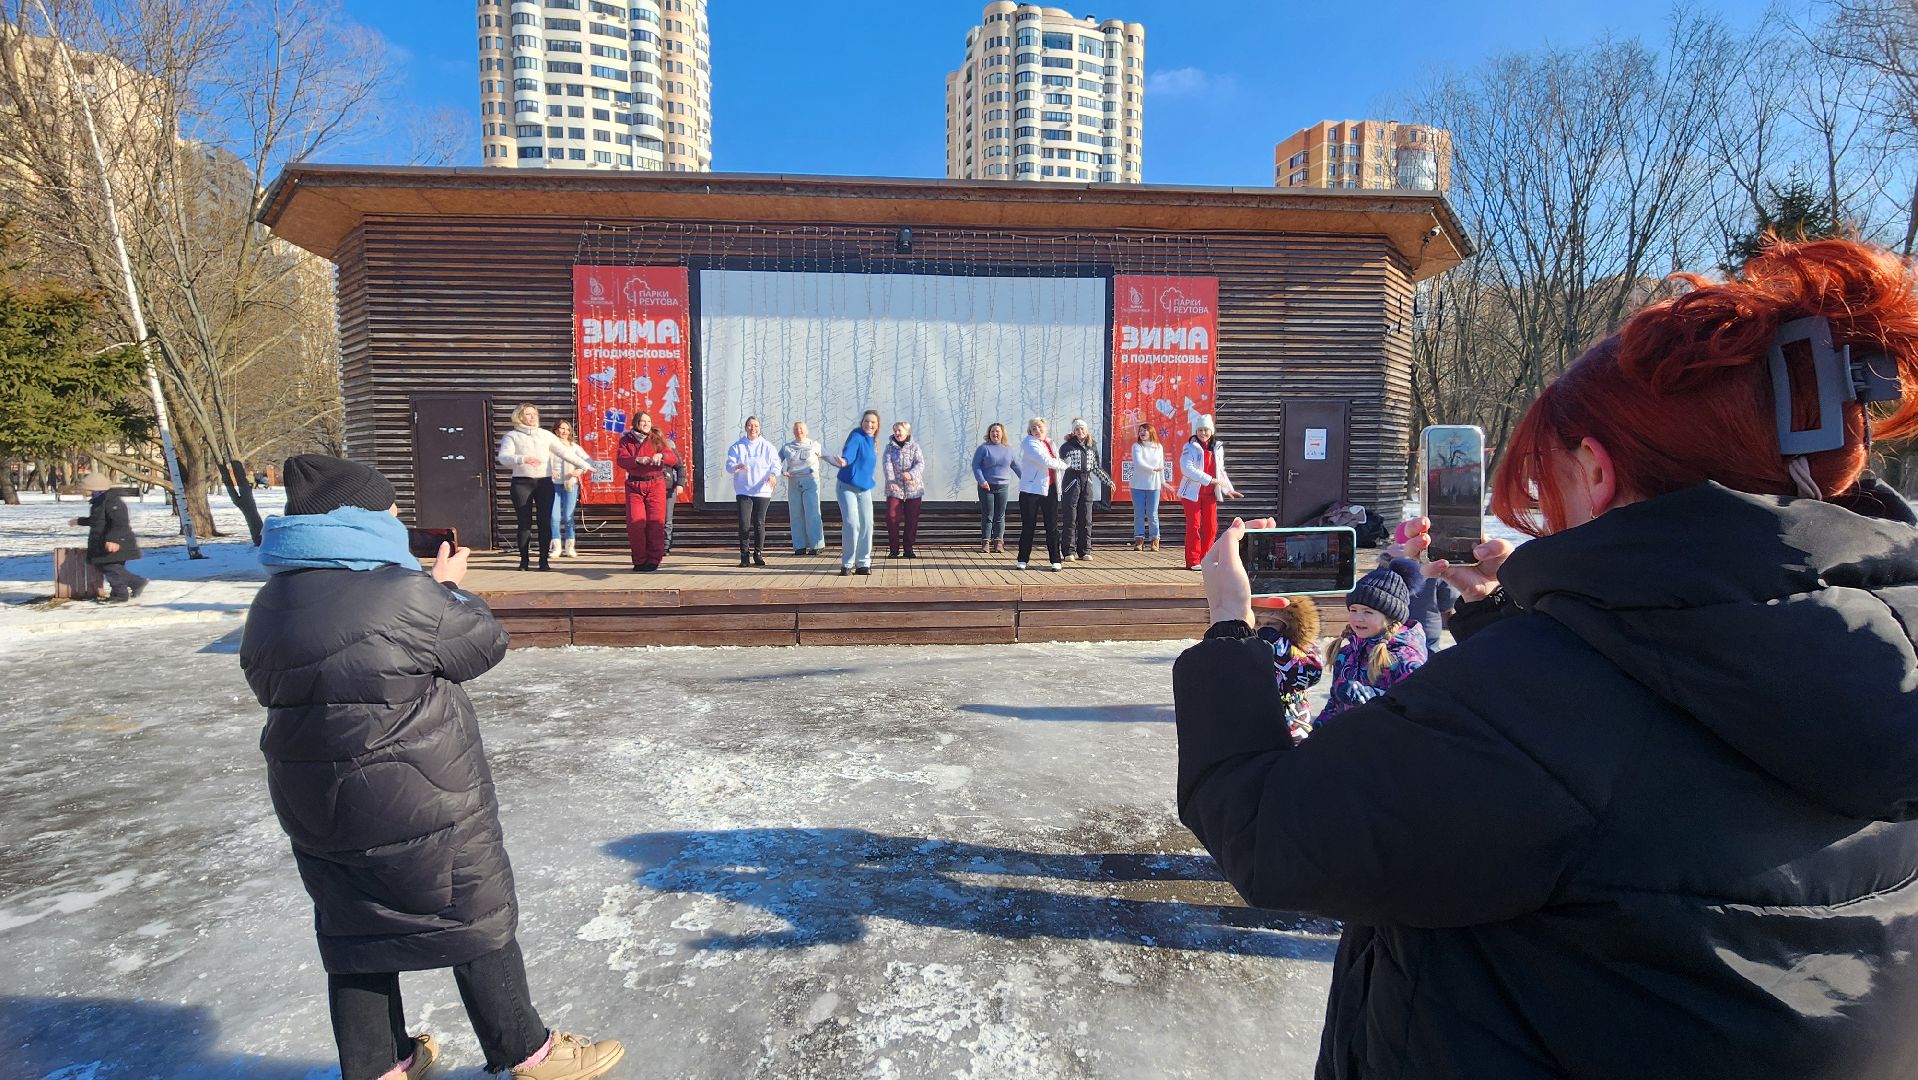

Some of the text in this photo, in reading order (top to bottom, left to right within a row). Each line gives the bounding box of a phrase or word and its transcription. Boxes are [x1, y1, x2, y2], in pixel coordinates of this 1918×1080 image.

[639, 298, 679, 306] РЕУТОВА
[1173, 306, 1209, 314] РЕУТОВА
[582, 318, 681, 344] ЗИМА
[1121, 326, 1209, 350] ЗИМА
[594, 349, 681, 359] ПОДМОСКОВЬЕ
[1130, 354, 1209, 364] ПОДМОСКОВЬЕ
